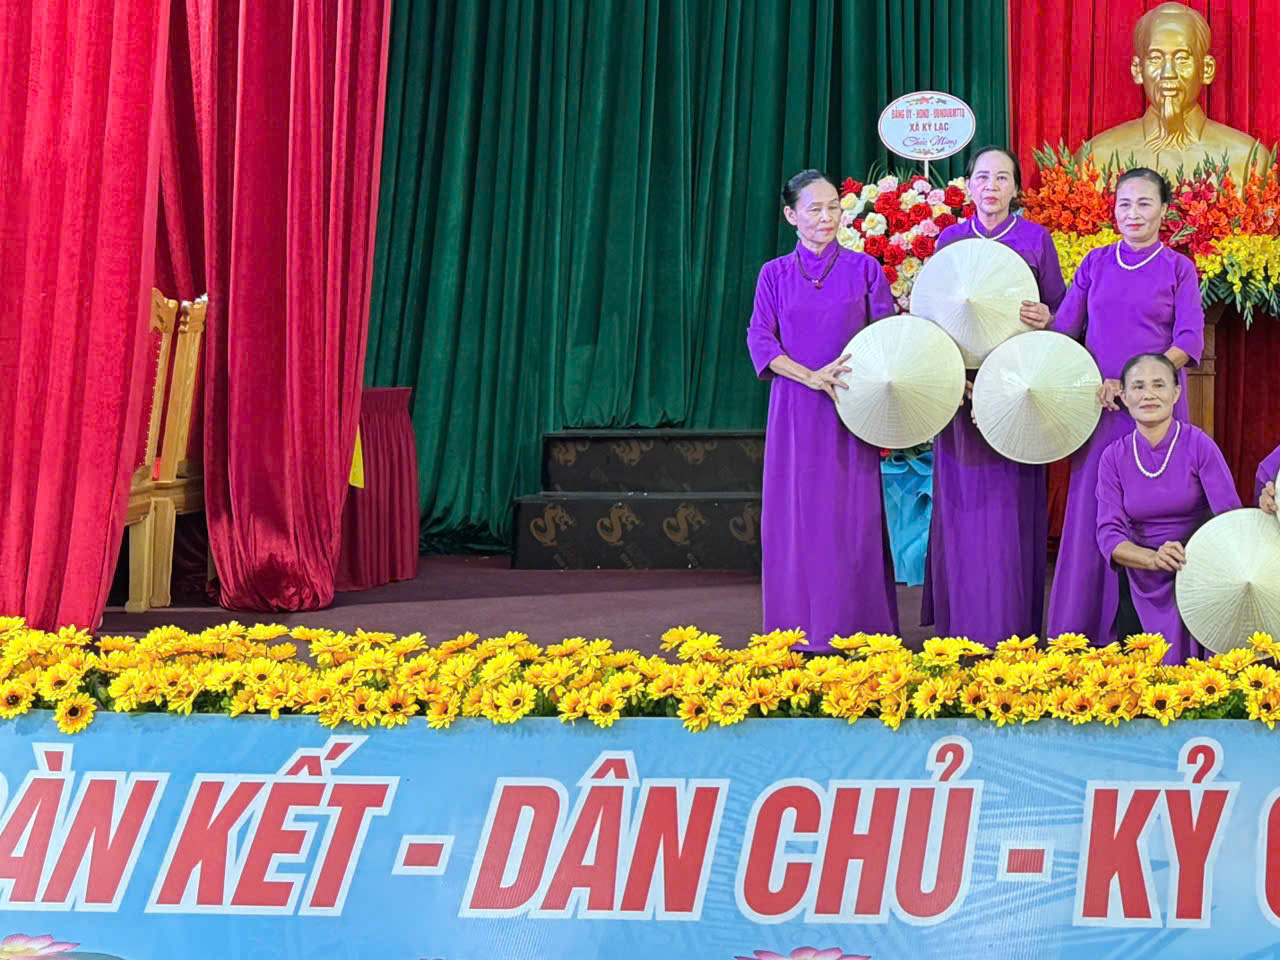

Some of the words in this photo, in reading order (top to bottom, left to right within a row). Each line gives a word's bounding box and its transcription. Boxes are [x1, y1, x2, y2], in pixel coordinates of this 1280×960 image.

[0, 748, 160, 904] ÀN
[155, 742, 388, 908] KẾT
[402, 842, 442, 867] -
[470, 758, 720, 914] DÂN
[742, 742, 974, 917] CHỦ
[1005, 849, 1046, 874] -
[1081, 743, 1228, 920] KỶ
